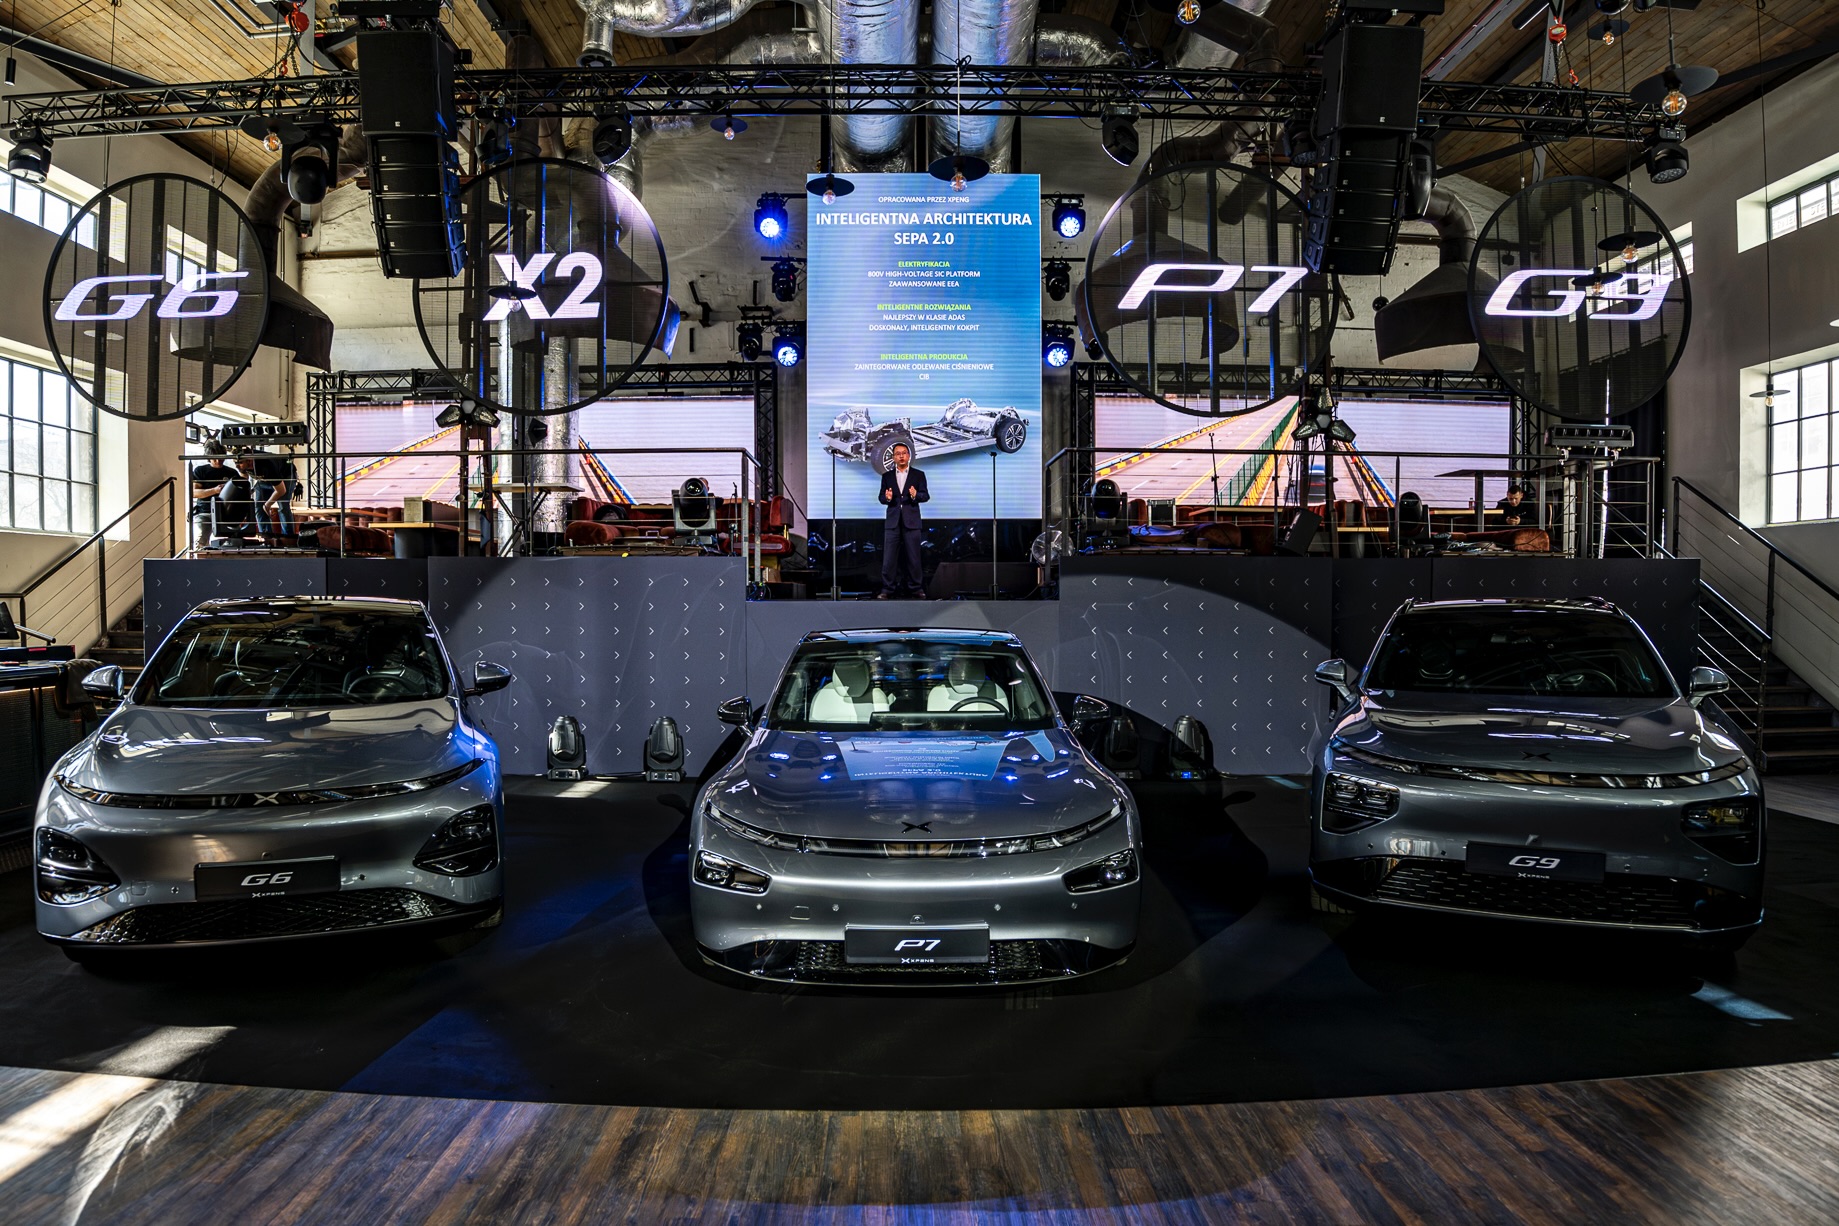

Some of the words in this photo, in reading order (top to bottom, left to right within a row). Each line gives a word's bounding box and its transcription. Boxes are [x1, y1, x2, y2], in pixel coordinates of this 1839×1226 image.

[816, 212, 920, 226] INTELIGENTNA
[924, 212, 1032, 226] ARCHITEKTURA
[894, 232, 929, 245] SEPA
[932, 232, 955, 245] 2.0
[482, 252, 602, 320] X2
[1118, 264, 1308, 312] P7
[54, 271, 250, 320] G6
[1484, 269, 1674, 320] G9
[924, 304, 971, 312] ROZWIĄZANIA
[1508, 855, 1560, 869] G9
[241, 872, 294, 886] G6
[894, 939, 941, 951] P7
